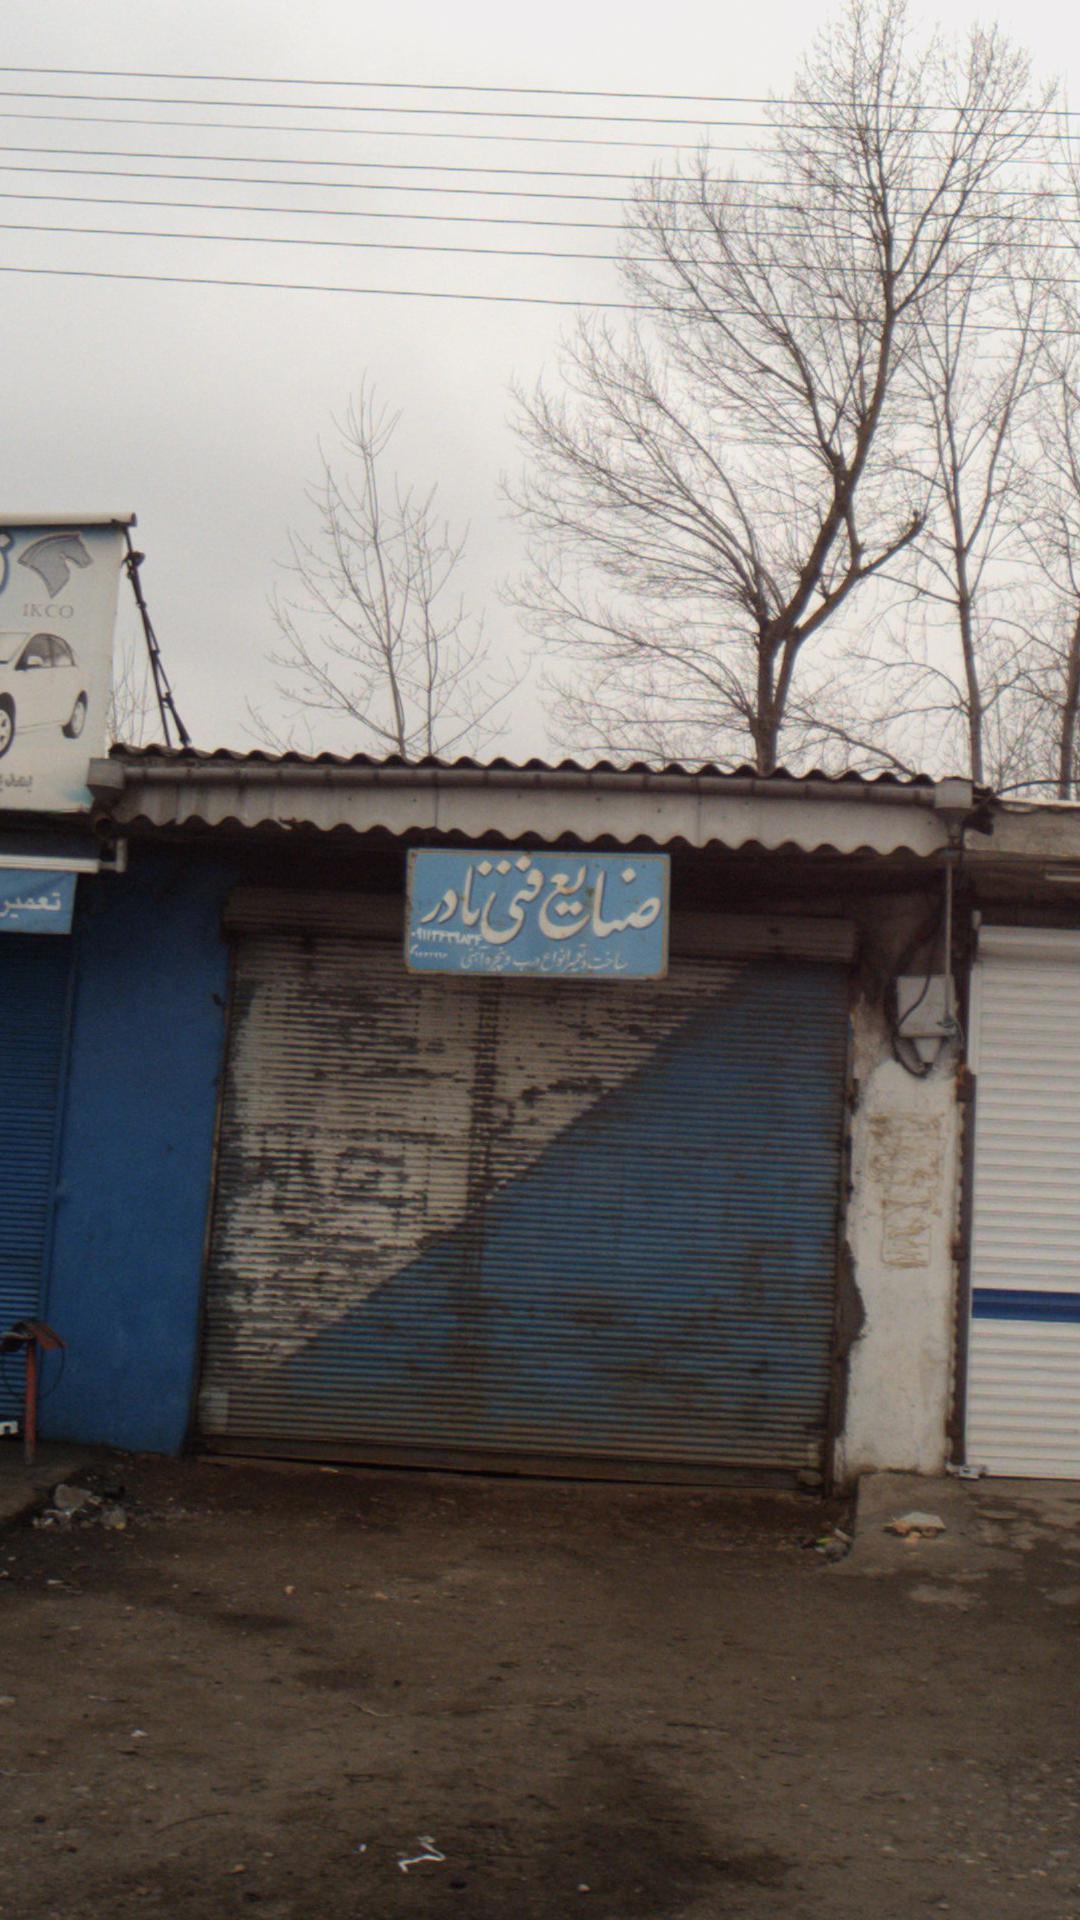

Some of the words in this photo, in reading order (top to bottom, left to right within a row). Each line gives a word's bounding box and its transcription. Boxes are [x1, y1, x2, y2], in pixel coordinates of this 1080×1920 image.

[22, 603, 75, 619] IKCO
[420, 860, 493, 926] نادر
[480, 856, 544, 944] فنی
[539, 865, 661, 940] صنایع
